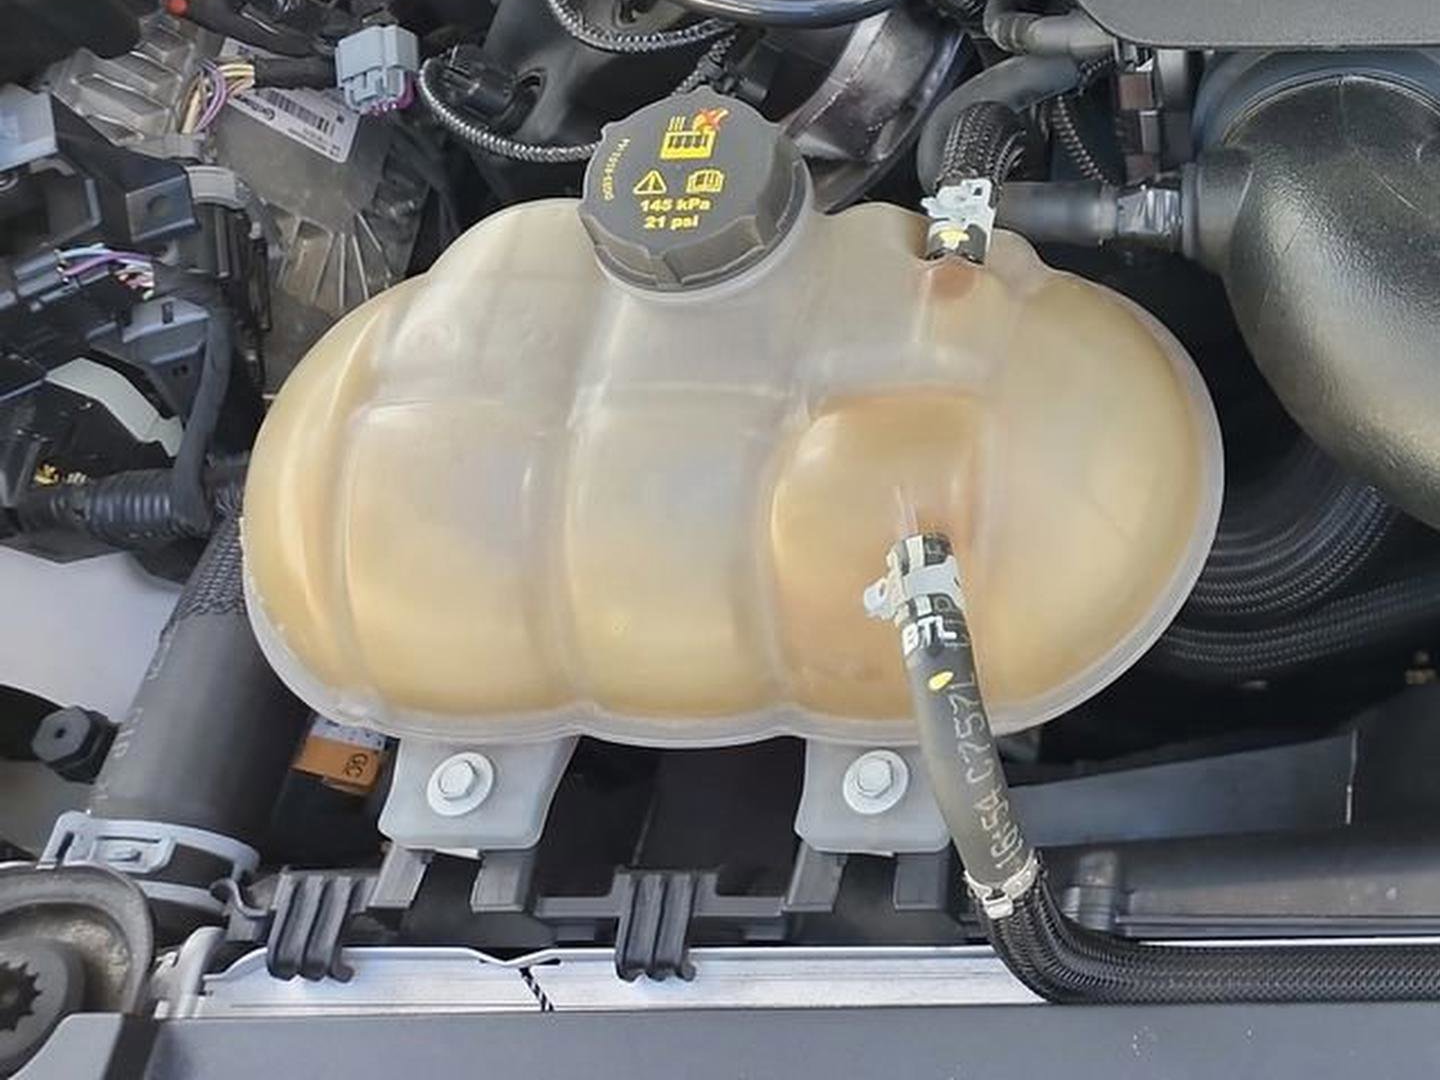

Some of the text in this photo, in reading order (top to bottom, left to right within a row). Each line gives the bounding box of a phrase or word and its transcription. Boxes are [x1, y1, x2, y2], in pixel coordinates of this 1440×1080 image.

[640, 197, 711, 212] 145 kPa
[644, 215, 699, 230] 21 psi
[902, 615, 957, 656] BTL
